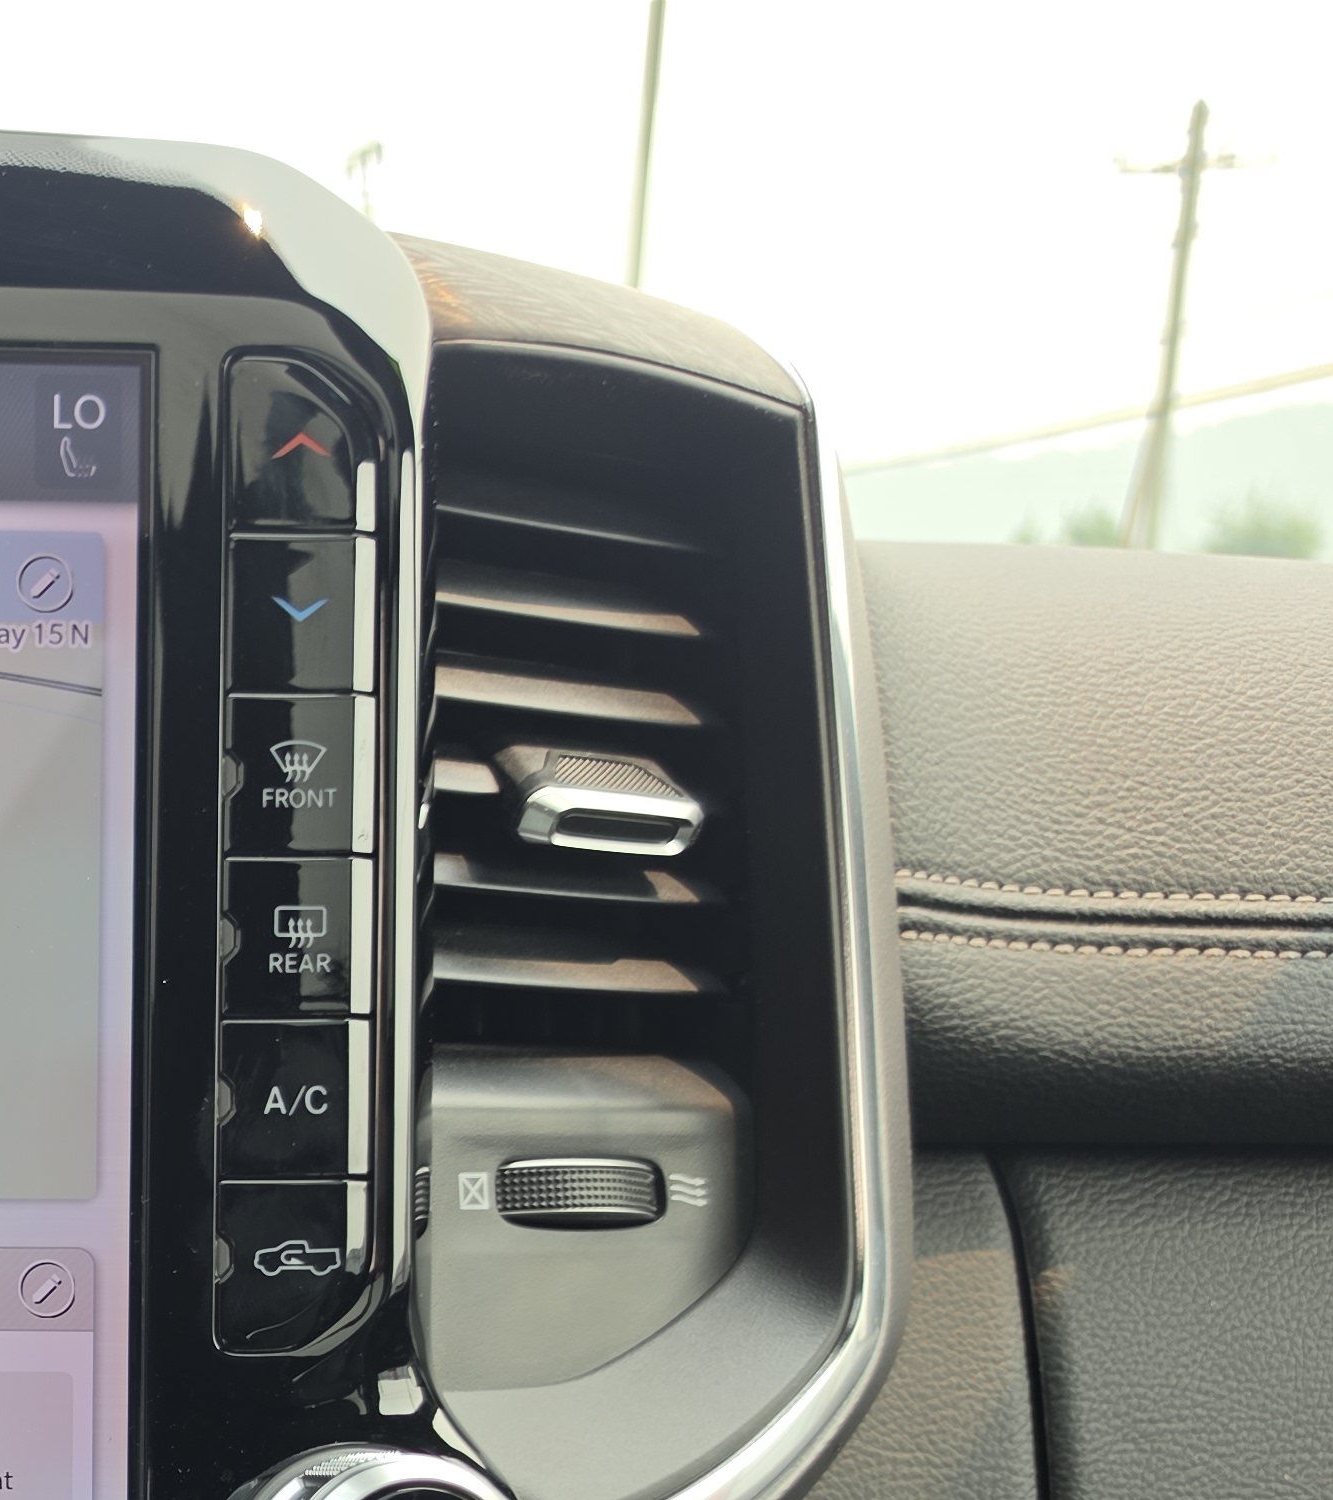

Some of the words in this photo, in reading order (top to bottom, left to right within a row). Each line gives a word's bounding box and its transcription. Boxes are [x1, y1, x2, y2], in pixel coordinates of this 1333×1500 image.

[53, 394, 106, 430] LO
[35, 623, 63, 645] 15
[71, 624, 89, 645] N
[262, 788, 337, 809] FRONT
[268, 953, 331, 974] REAR
[263, 1085, 328, 1116] A/C
